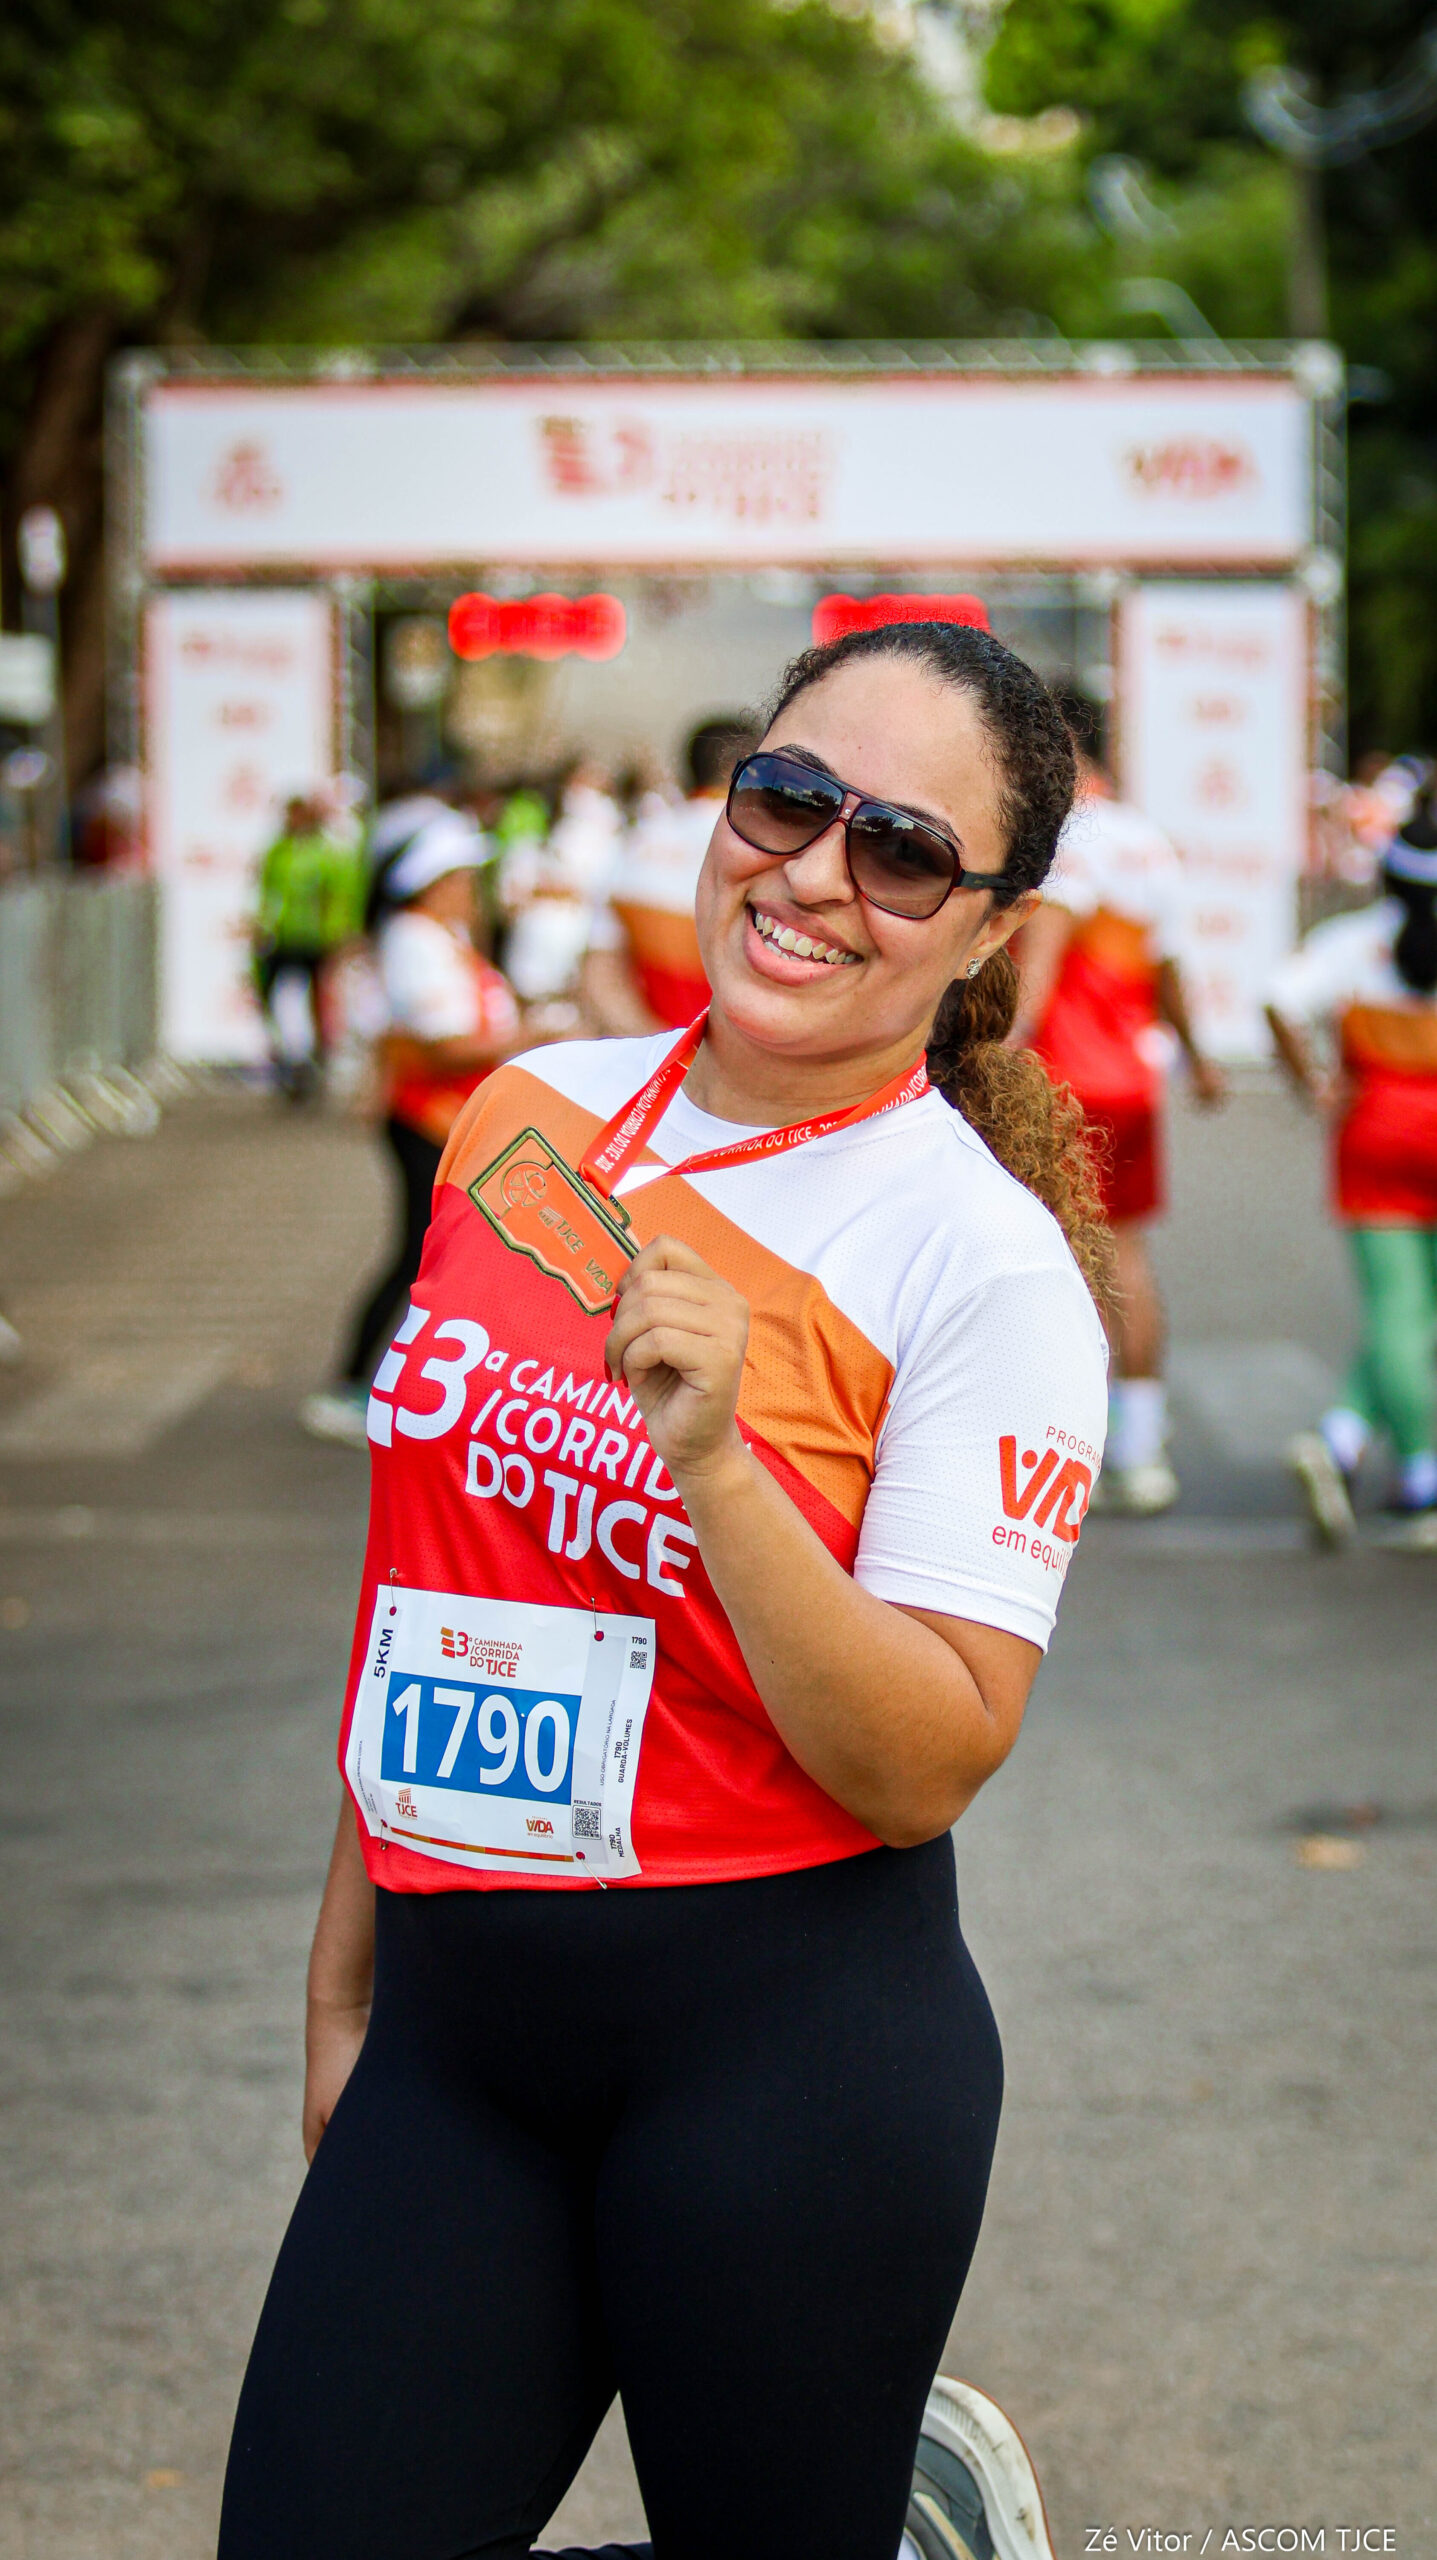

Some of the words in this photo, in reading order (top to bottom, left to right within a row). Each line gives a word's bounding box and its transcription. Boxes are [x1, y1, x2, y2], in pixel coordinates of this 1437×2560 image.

[556, 1219, 585, 1254] TJCE
[470, 1389, 683, 1502] /CORRID
[465, 1440, 535, 1509] DO
[543, 1468, 699, 1599] TJCE
[992, 1525, 1027, 1553] em
[373, 1628, 394, 1679] 5KM
[474, 1638, 523, 1651] CAMINHADA
[632, 1636, 648, 1645] 1790
[470, 1655, 485, 1668] DO
[486, 1658, 517, 1678] TJCE
[392, 1683, 571, 1793] 1790
[614, 1741, 622, 1758] 1790
[618, 1719, 633, 1784] GUARDA-VOLUMES
[395, 1802, 418, 1818] TJCE
[526, 1819, 554, 1834] VIDA
